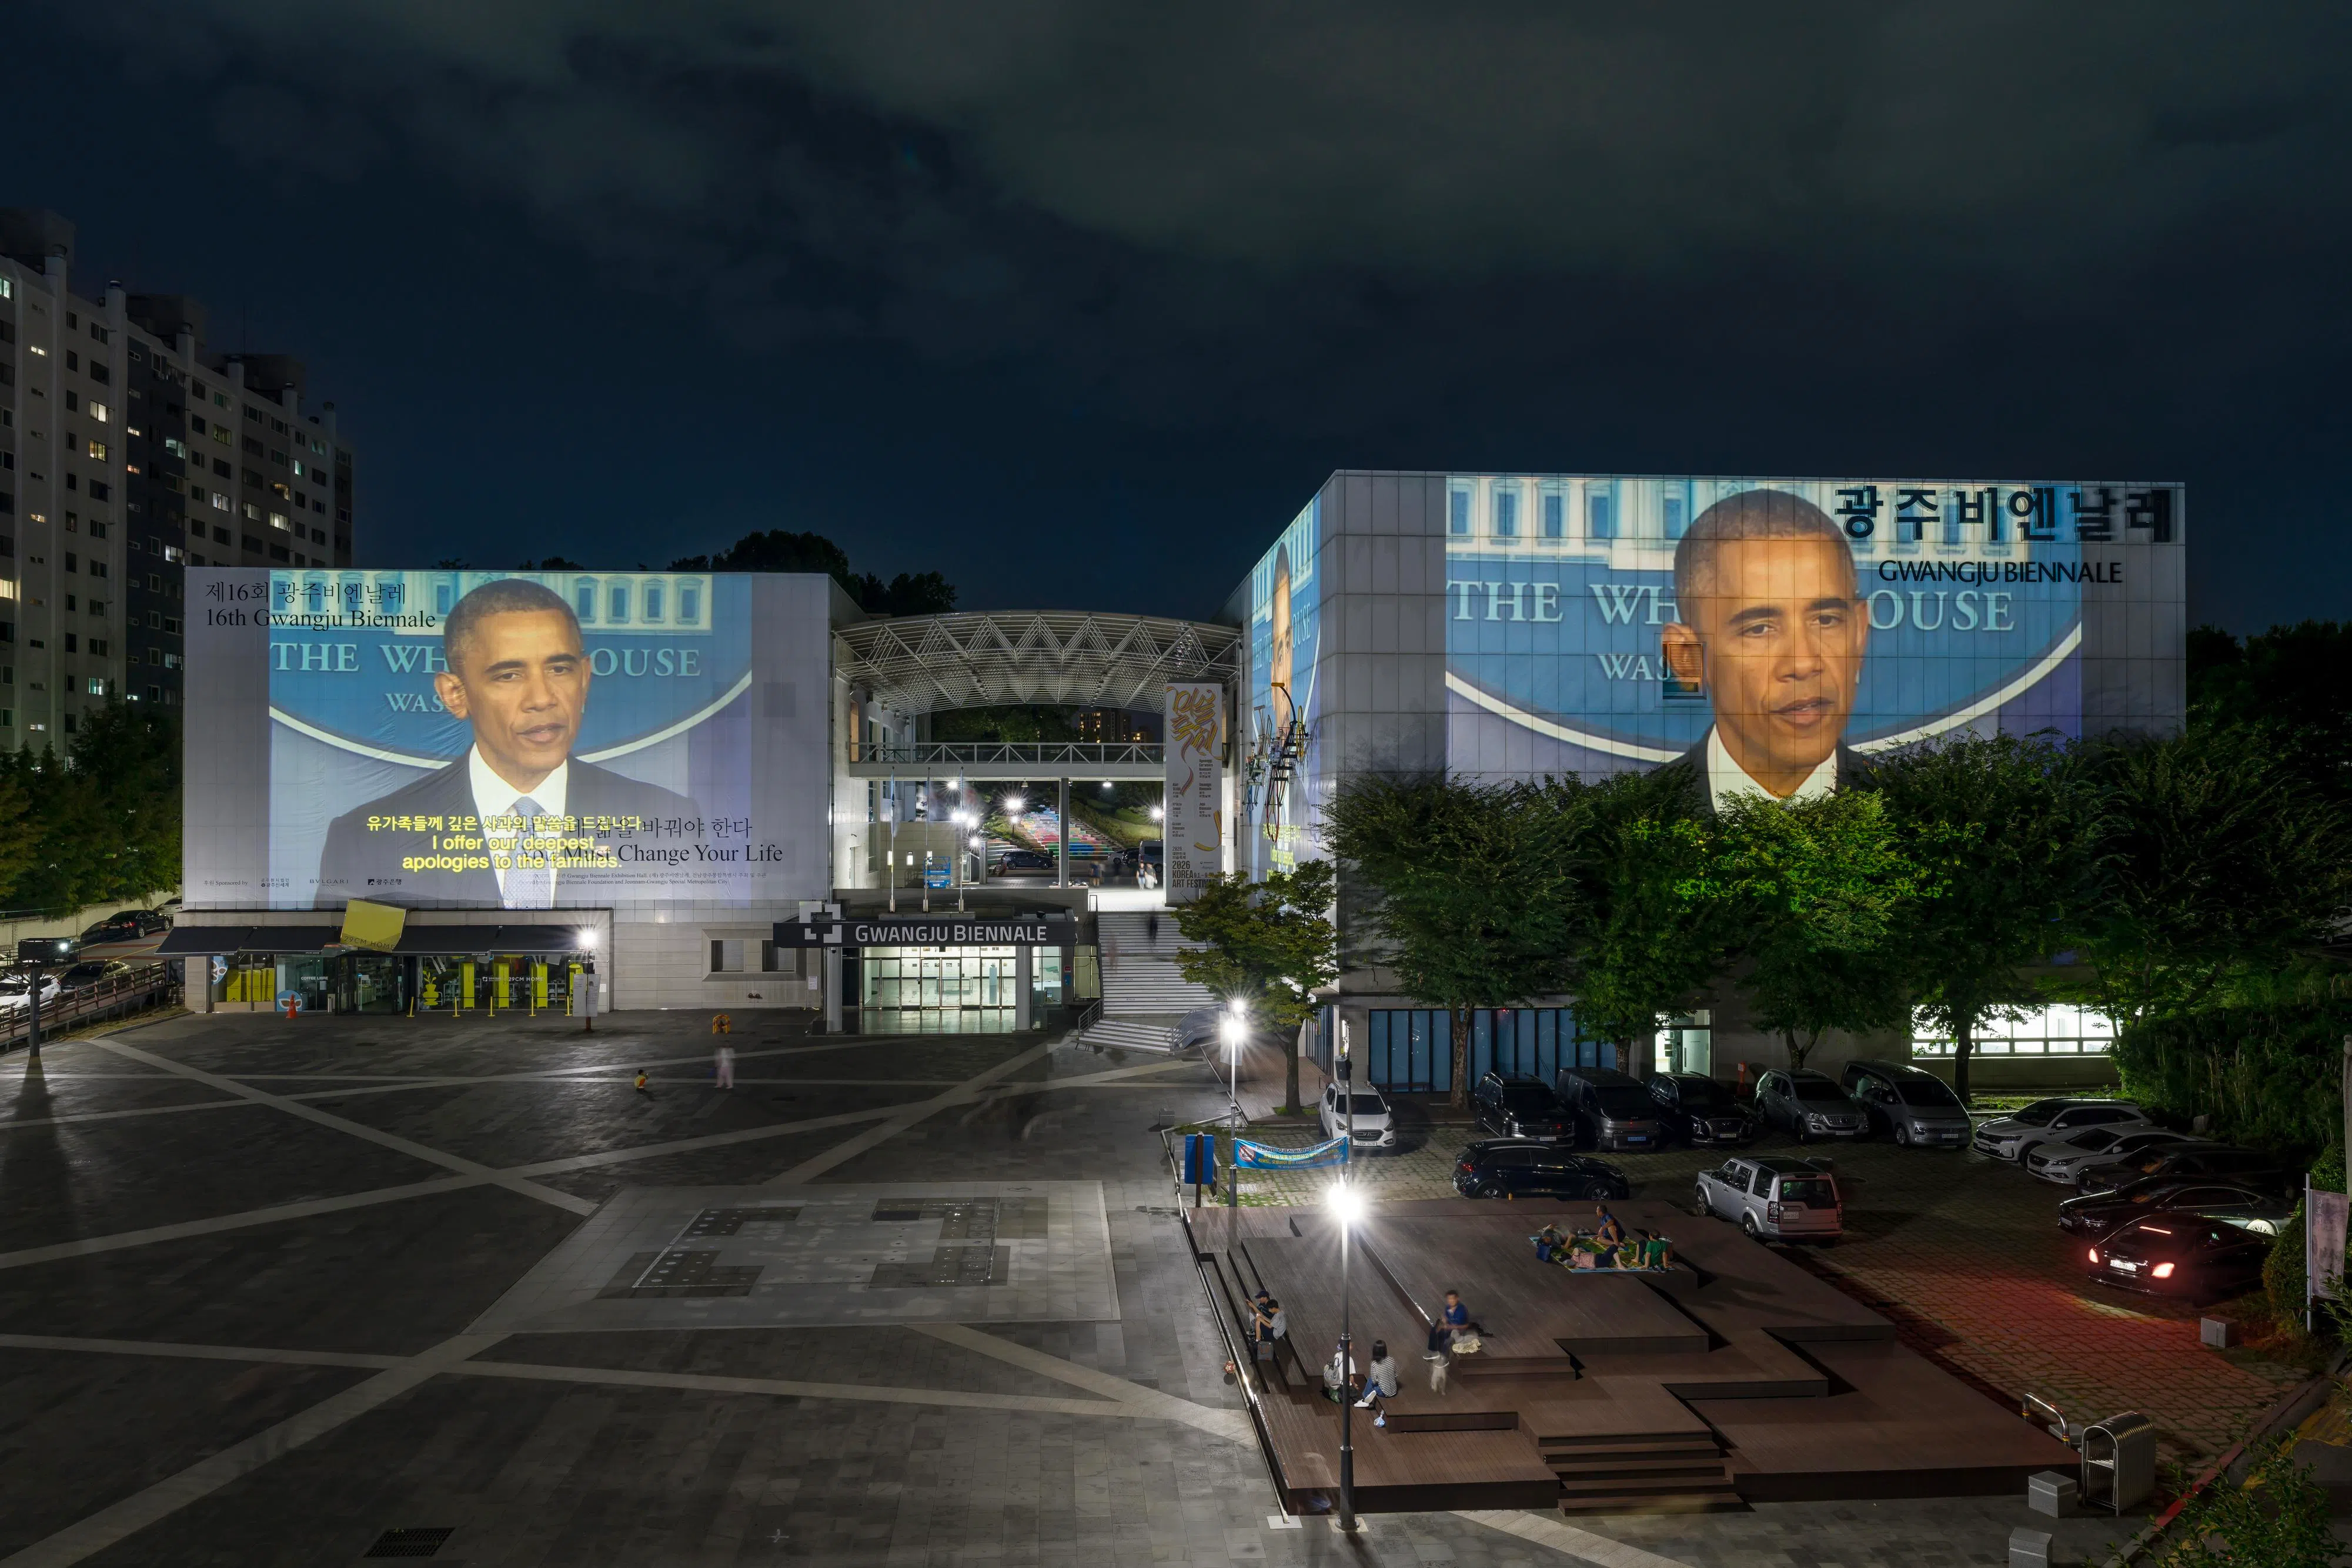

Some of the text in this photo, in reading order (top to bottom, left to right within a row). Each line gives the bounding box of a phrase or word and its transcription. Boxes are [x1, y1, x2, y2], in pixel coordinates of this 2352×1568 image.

[1835, 486, 2171, 543] 광주비엔날레
[1879, 560, 2123, 587] GWANGJU BIENNALE
[205, 581, 406, 604] 제16회 광주비엔날레
[1446, 580, 1563, 623] THE
[1855, 590, 2015, 632] OUSE
[206, 609, 436, 631] 16th Gwangju Biennale
[1292, 601, 1311, 650] OUSE
[270, 642, 360, 673] THE
[581, 648, 700, 677] OUSE
[367, 815, 443, 831] 유가족들께
[448, 815, 478, 831] 깊은
[482, 815, 527, 832] 사과의
[582, 815, 645, 831] 드립니다.
[643, 817, 705, 839] 바꿔야
[711, 817, 753, 839] 한다
[443, 835, 483, 850] offer
[489, 837, 518, 851] our
[523, 835, 595, 853] deepest
[618, 844, 690, 866] Change
[693, 844, 739, 862] Your
[744, 844, 783, 862] Life
[402, 852, 622, 872] apologies to the families.
[1172, 861, 1191, 870] 2026
[1172, 870, 1193, 879] KOREA
[1172, 880, 1185, 888] ART
[344, 936, 396, 950] 29CM HOME
[855, 925, 1047, 942] GWANGJU BIENNALE
